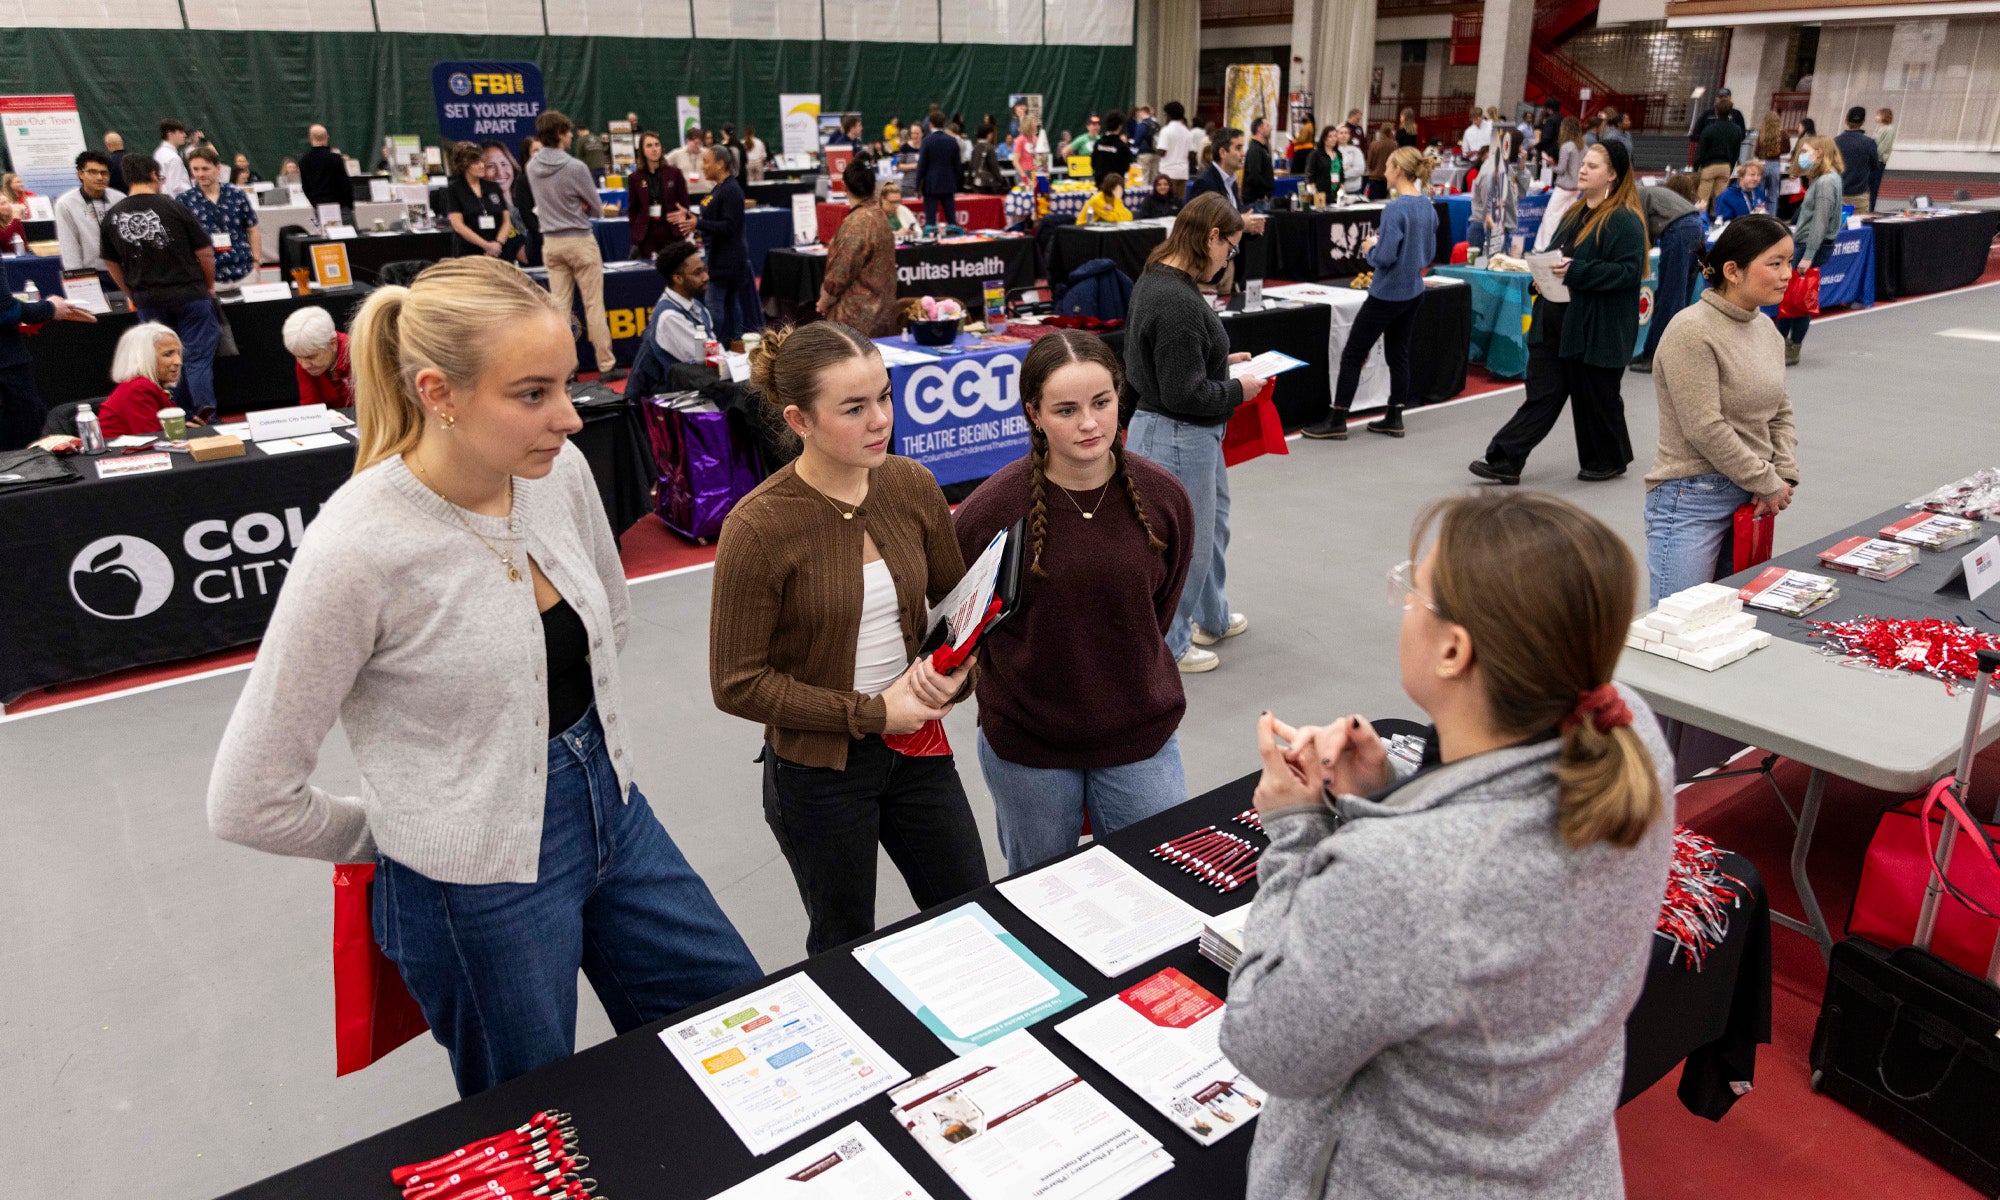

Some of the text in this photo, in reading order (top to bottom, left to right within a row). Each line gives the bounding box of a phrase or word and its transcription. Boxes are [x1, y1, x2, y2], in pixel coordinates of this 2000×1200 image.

[472, 73, 514, 95] FBI
[444, 102, 540, 118] SET YOURSELF
[7, 117, 75, 127] Join Our Team
[474, 119, 517, 134] APART
[1517, 208, 1546, 218] OLUMBU
[1842, 240, 1861, 254] HERE
[896, 256, 1004, 286] quitas Health
[605, 307, 646, 340] BI
[911, 360, 1017, 418] CCT
[902, 415, 1030, 455] THEATRE BEGINS HERE
[183, 504, 318, 562] COL
[1203, 1056, 1226, 1071] armacy
[821, 1096, 848, 1112] Future
[770, 1114, 810, 1137] Pharmacy
[1116, 1134, 1139, 1149] Doctor
[1040, 1128, 1131, 1182] Admissions and Outcomes
[1071, 1153, 1107, 1176] Pharmacy
[1033, 1173, 1070, 1197] (PharmD)
